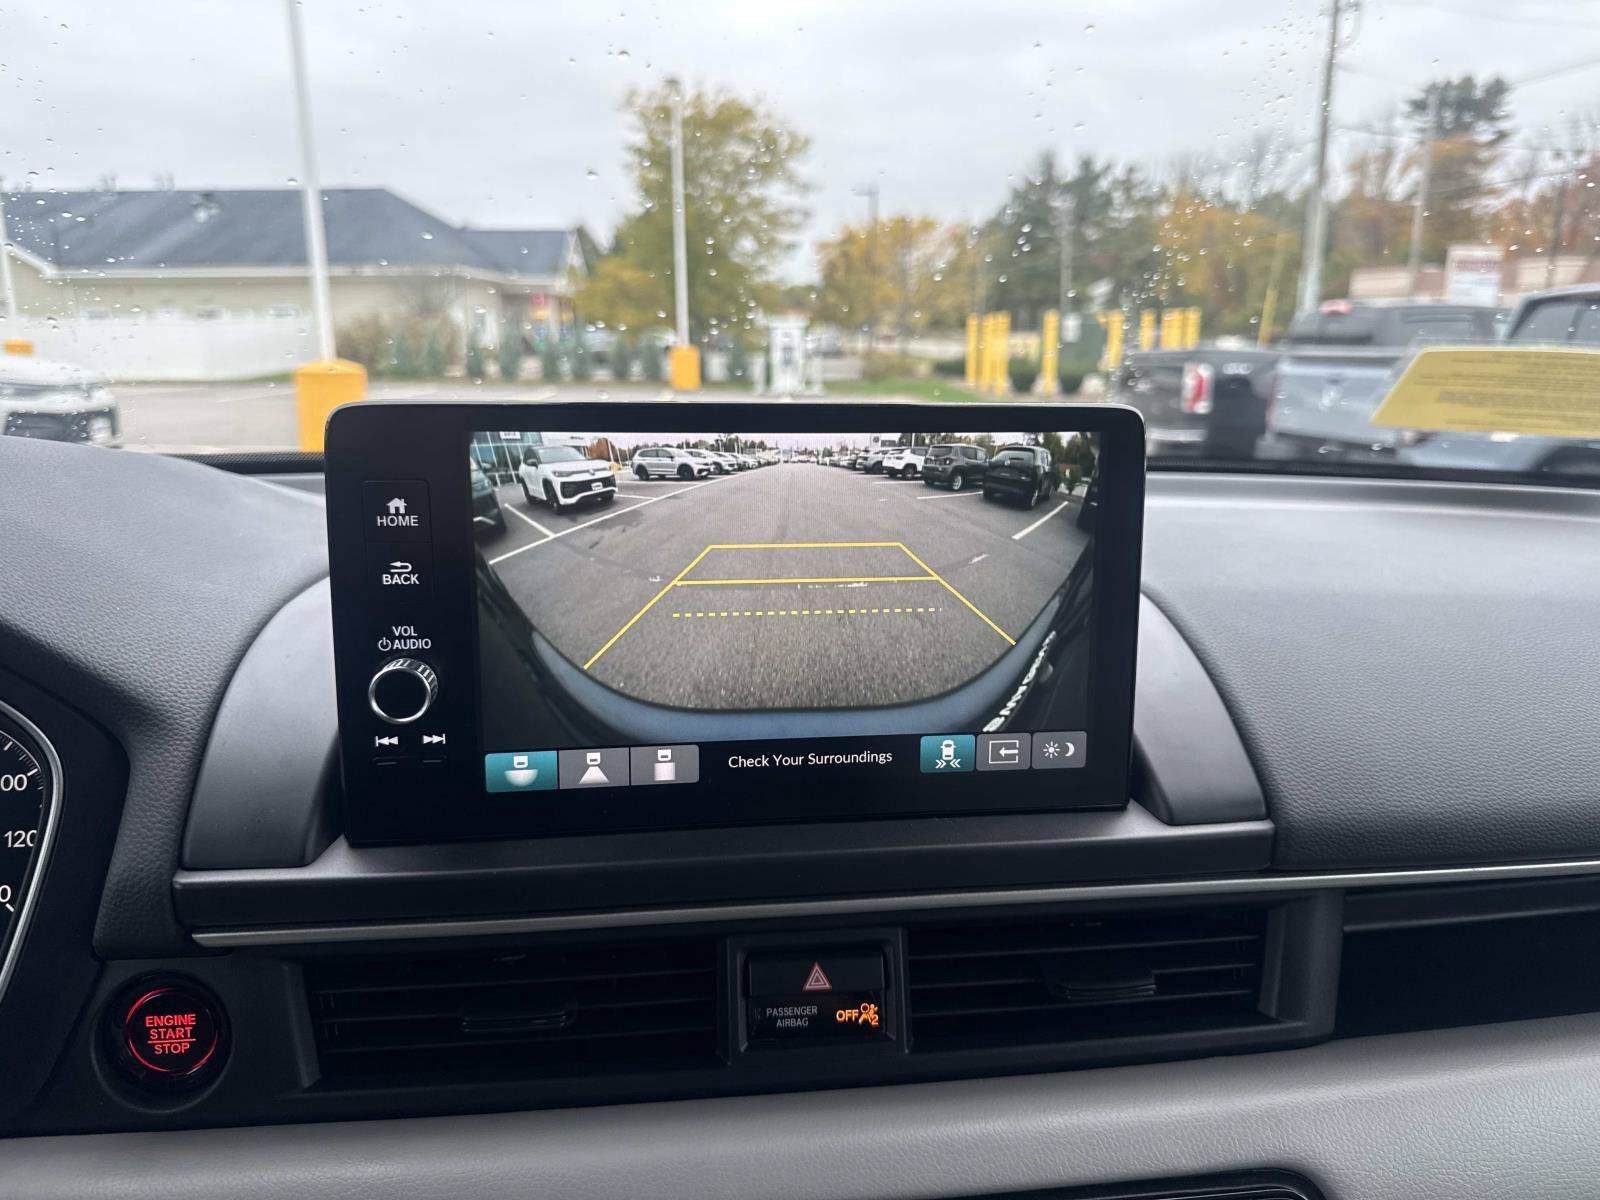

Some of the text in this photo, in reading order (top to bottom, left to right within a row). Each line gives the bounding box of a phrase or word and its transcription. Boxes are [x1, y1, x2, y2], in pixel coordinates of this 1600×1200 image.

[376, 515, 419, 527] HOME
[382, 573, 420, 585] BACK
[392, 625, 418, 637] VOL
[393, 638, 432, 650] AUDIO
[728, 750, 893, 768] Check Your Surroundings
[766, 1005, 818, 1017] PASSENGER
[836, 1009, 859, 1023] OFF
[145, 1014, 196, 1027] ENGINE
[776, 1017, 809, 1029] AIRBAG
[150, 1026, 193, 1040] START
[154, 1042, 190, 1055] STOP
